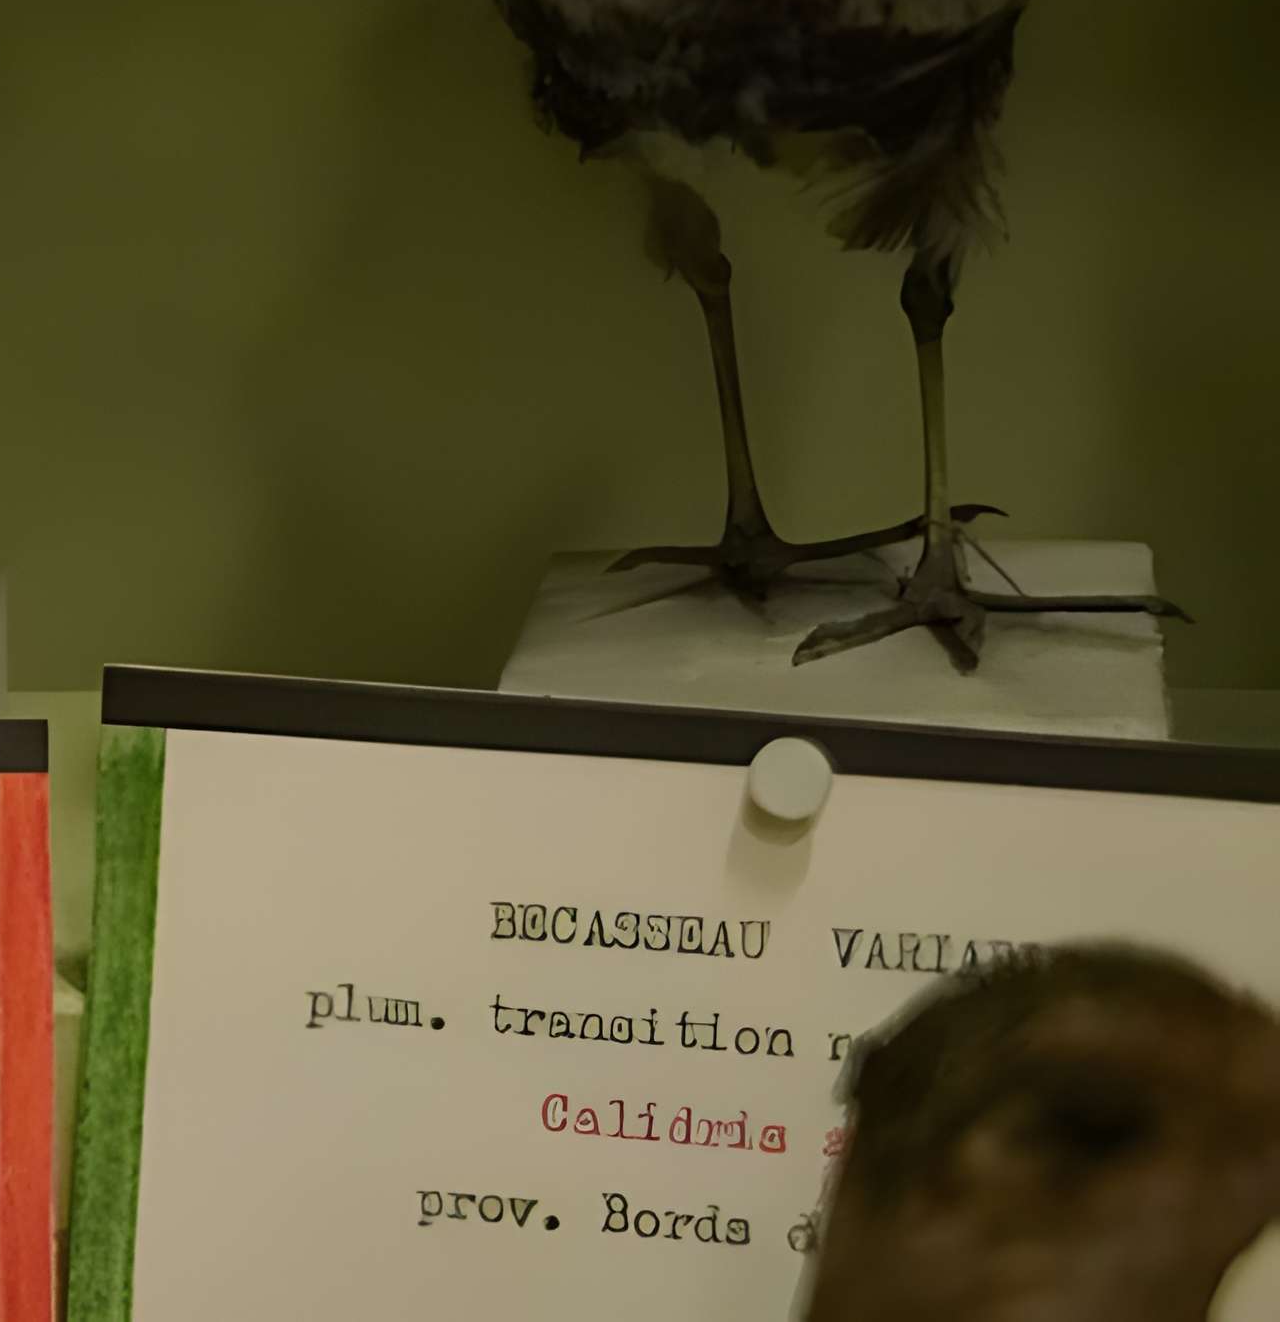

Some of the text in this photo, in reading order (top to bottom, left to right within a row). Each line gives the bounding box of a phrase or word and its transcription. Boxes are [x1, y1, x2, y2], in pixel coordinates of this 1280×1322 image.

[489, 902, 771, 959] BECASSEAU
[305, 983, 445, 1030] plum.
[488, 994, 795, 1058] transition
[541, 1094, 787, 1154] Calidris
[416, 1190, 560, 1231] prov.
[601, 1193, 751, 1246] Bords
